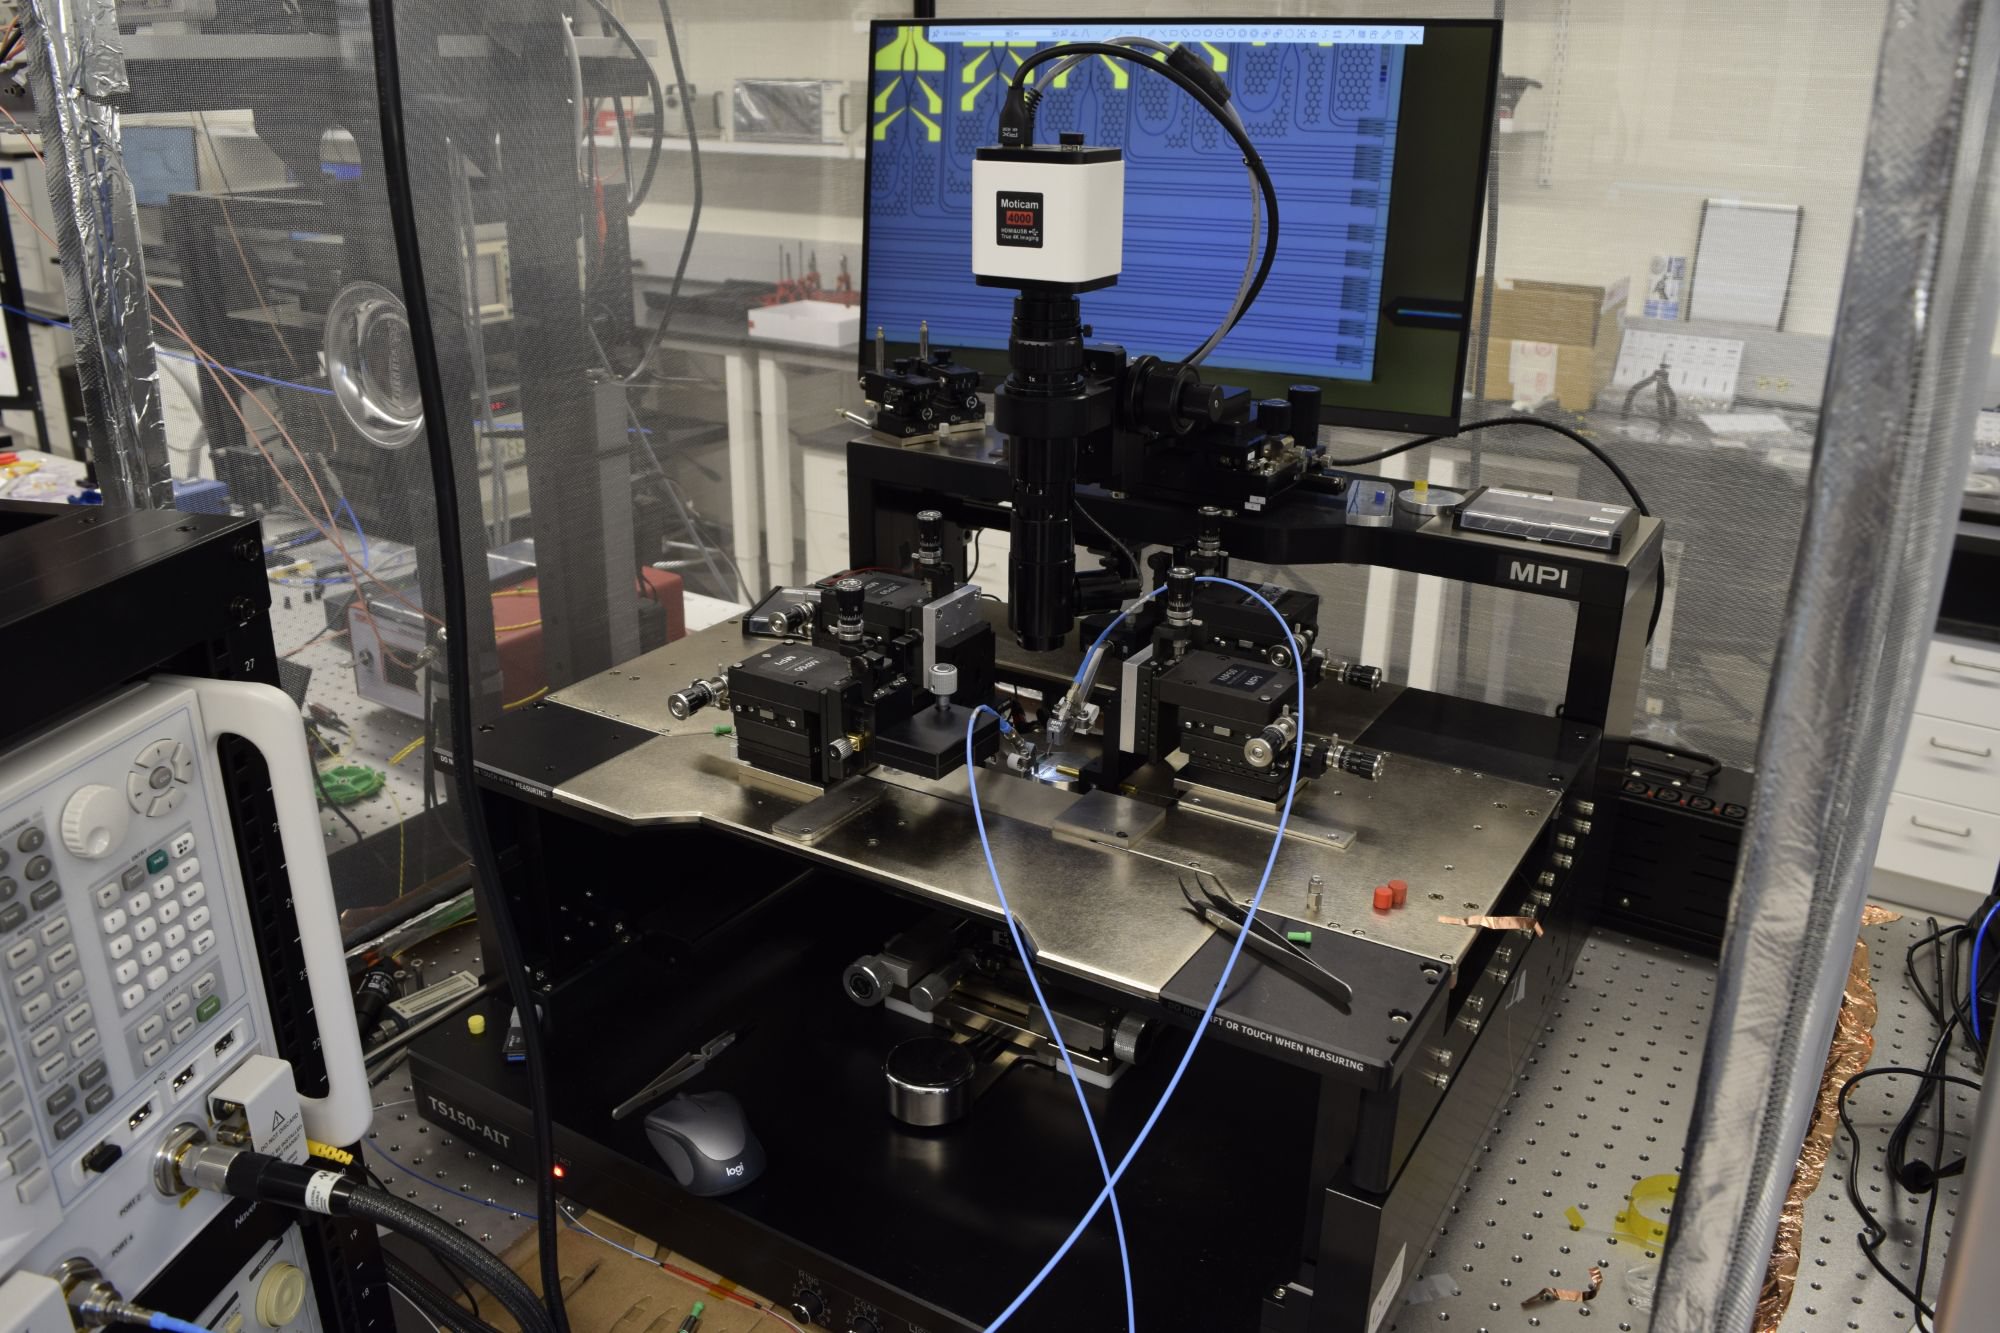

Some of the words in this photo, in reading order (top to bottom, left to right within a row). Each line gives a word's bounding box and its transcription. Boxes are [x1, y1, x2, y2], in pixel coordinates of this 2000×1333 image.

[1001, 198, 1039, 210] Moticam
[1008, 212, 1031, 224] 4000
[1509, 561, 1568, 589] MPI
[244, 657, 255, 671] 27
[515, 781, 547, 798] MEASURING
[1225, 1020, 1239, 1032] OR
[1241, 1025, 1273, 1043] TOUCH
[1275, 1035, 1304, 1053] WHEN
[1306, 1045, 1364, 1072] MEASURING
[428, 1095, 510, 1148] TS150-AIT
[260, 1141, 269, 1153] DO
[268, 1130, 279, 1146] NOT
[278, 1112, 299, 1138] DISCARD
[726, 1161, 744, 1177] logi
